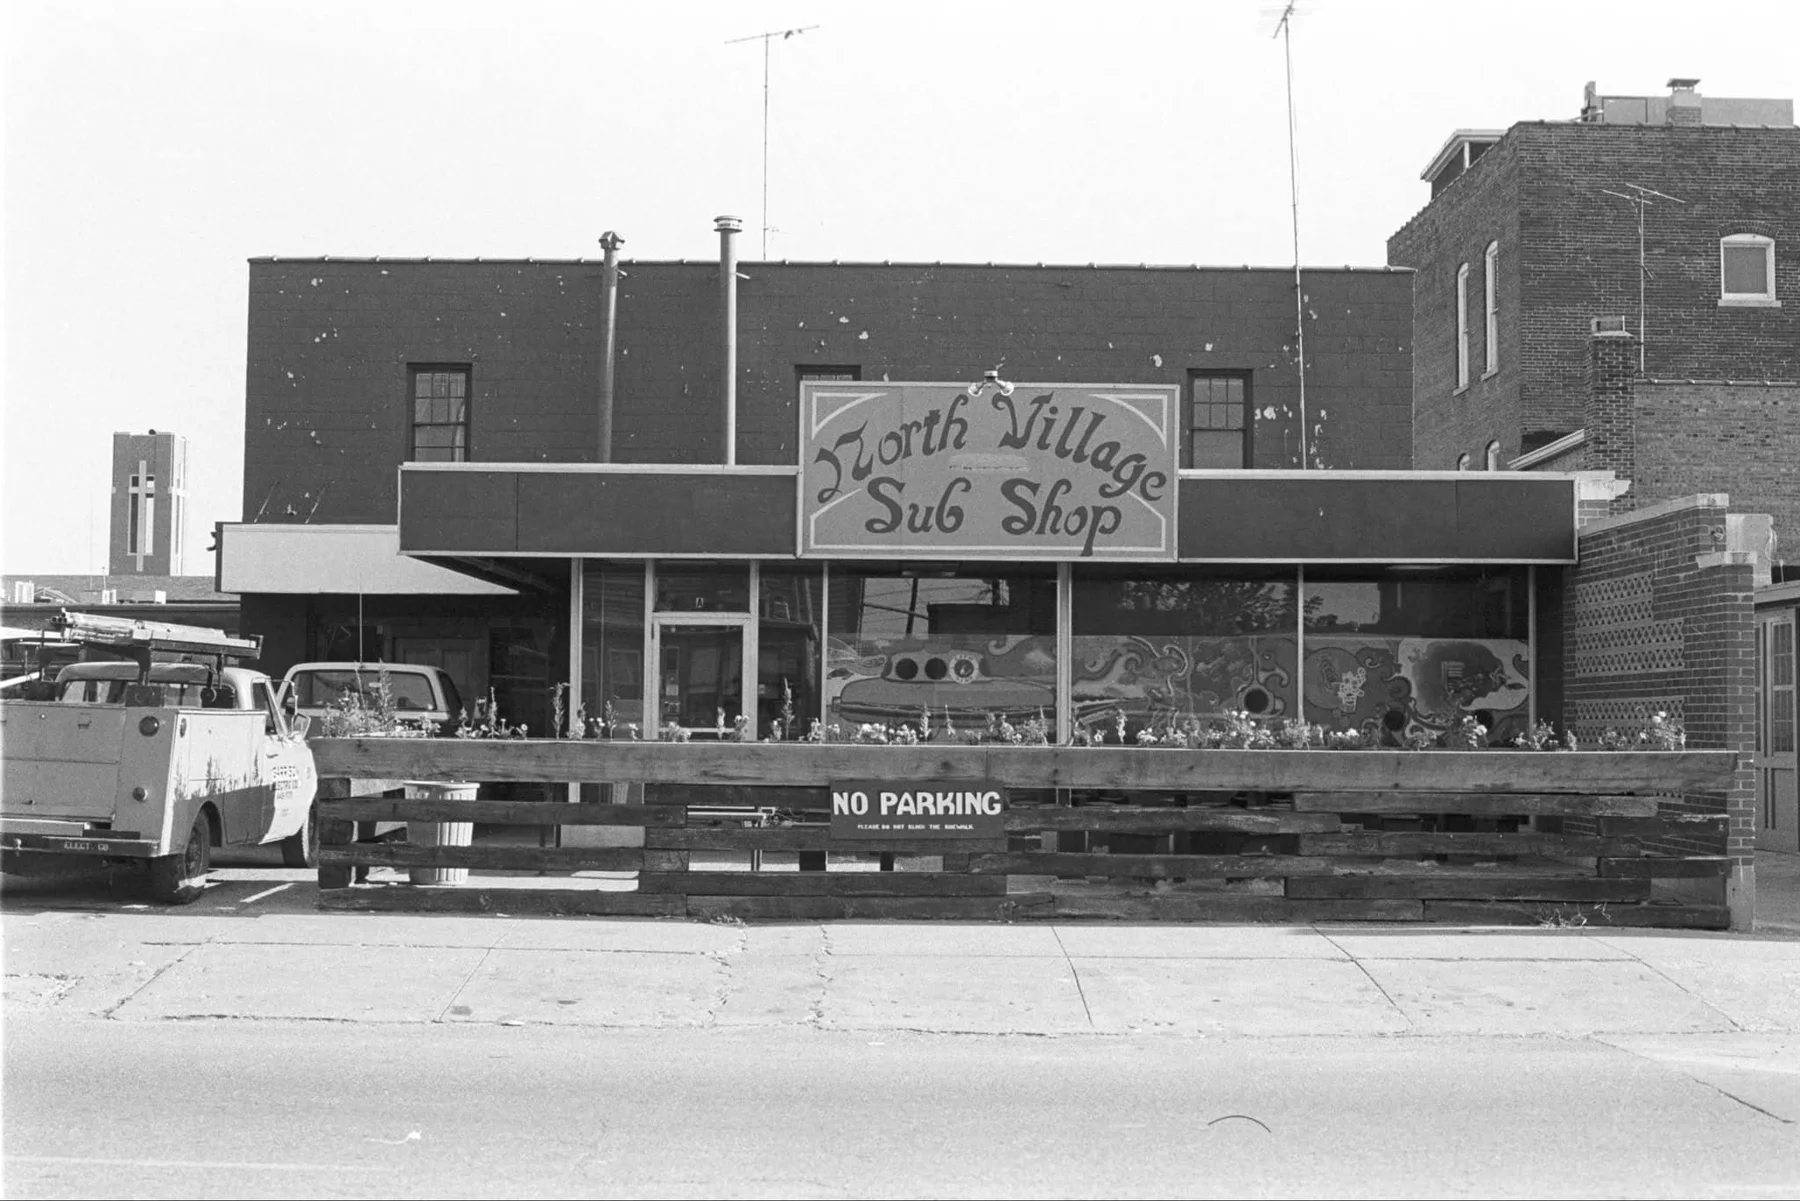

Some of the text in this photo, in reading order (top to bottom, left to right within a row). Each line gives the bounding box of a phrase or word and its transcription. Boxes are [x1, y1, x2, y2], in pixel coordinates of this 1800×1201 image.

[814, 391, 1167, 503] North Village
[865, 476, 1122, 556] Sub Shop
[832, 791, 1002, 815] NO PARKING
